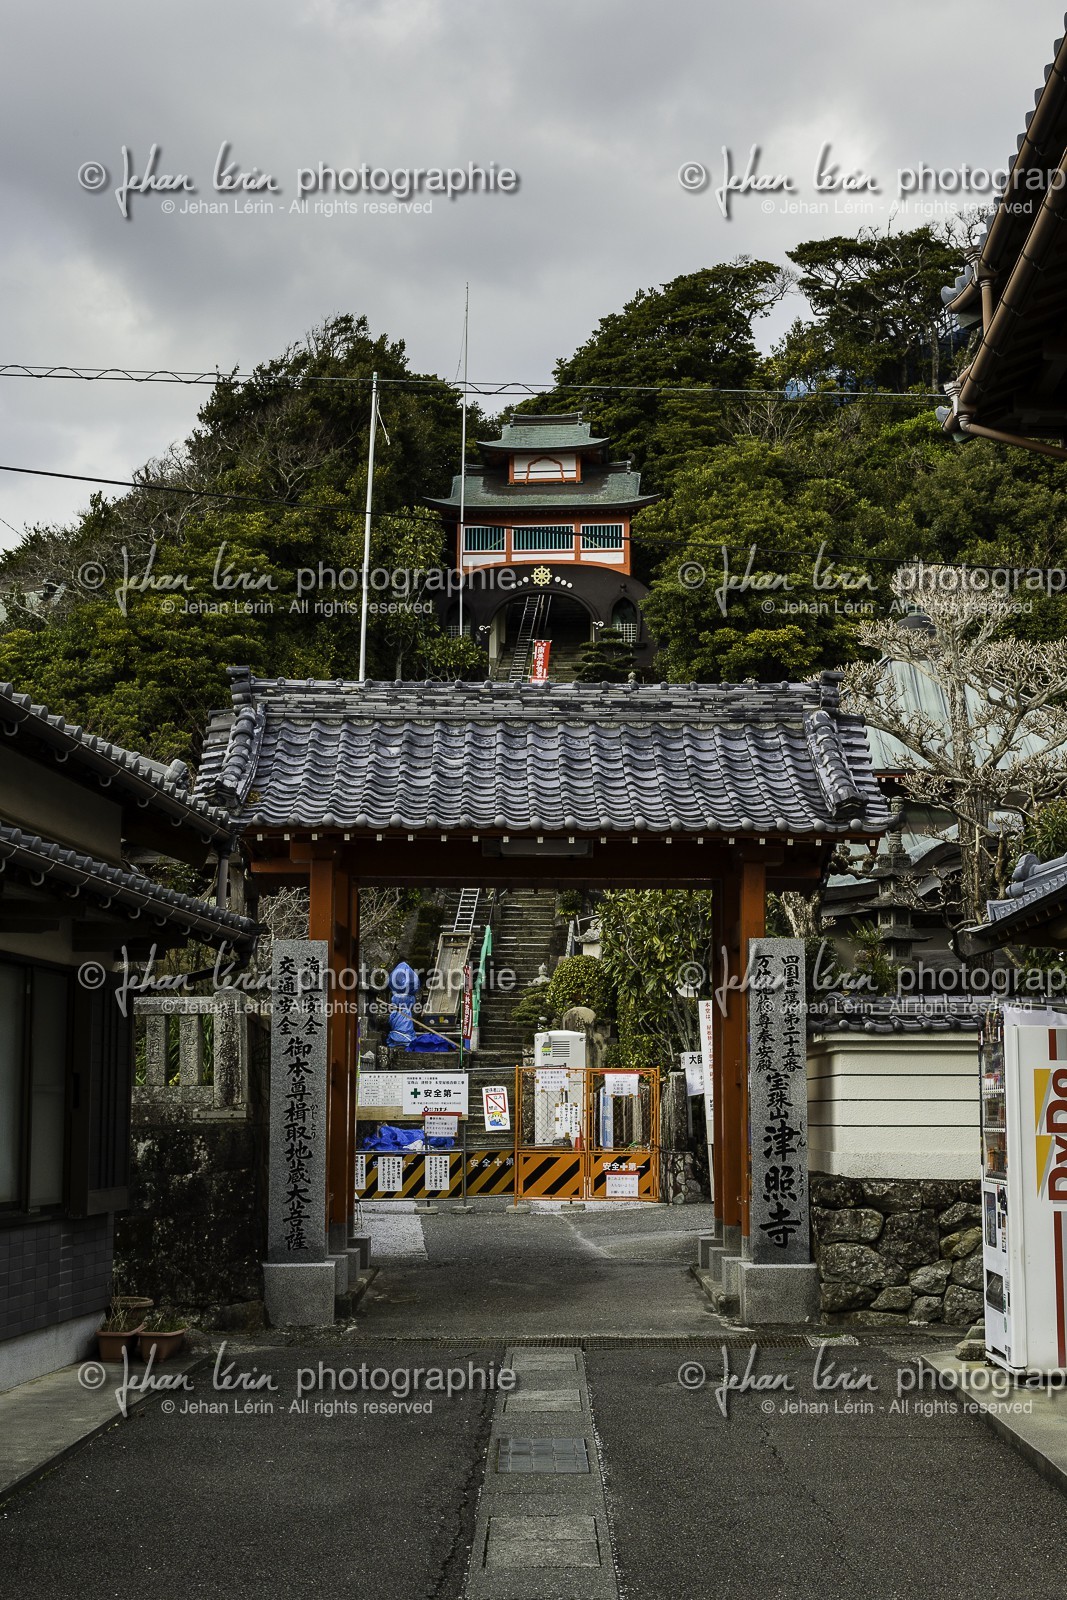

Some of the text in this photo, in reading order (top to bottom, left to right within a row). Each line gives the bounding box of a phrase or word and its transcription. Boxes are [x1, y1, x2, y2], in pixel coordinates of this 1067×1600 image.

[276, 955, 298, 1036] 交通安全
[423, 1088, 462, 1098] 安全第一
